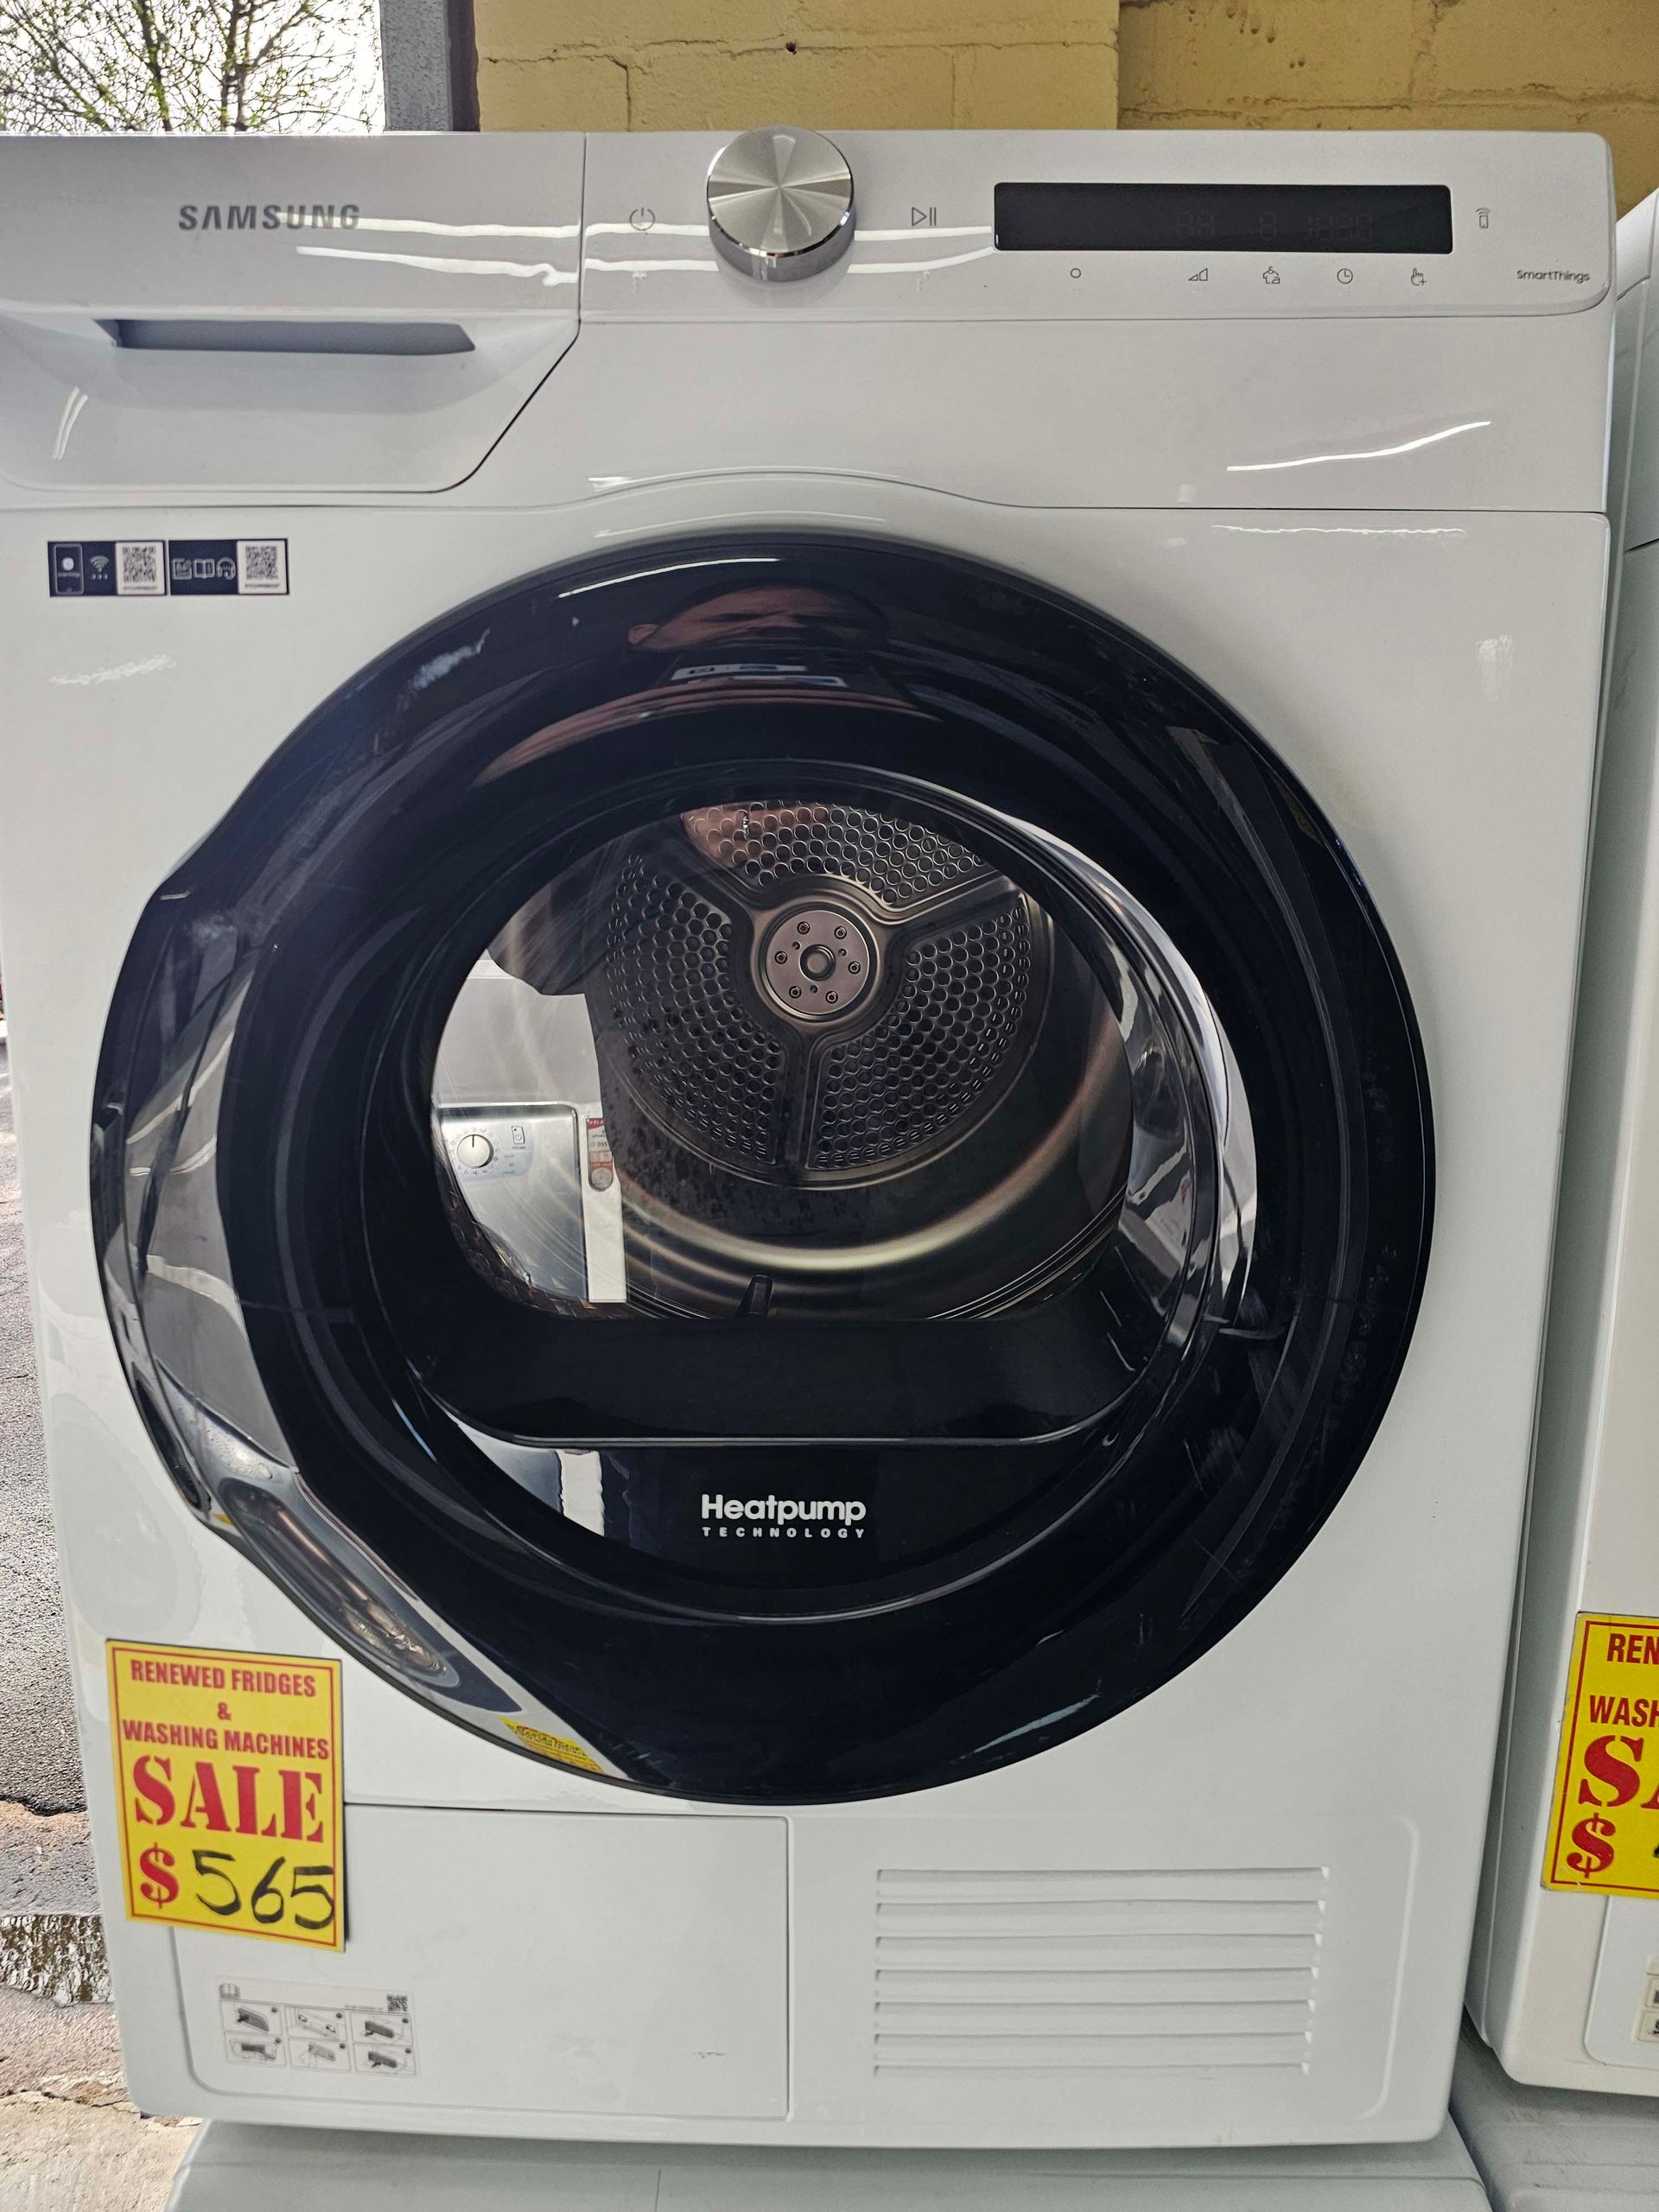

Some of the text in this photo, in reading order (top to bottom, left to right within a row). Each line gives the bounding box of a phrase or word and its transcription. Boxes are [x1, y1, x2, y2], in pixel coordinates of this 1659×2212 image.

[179, 204, 360, 231] SAMSUNG
[1516, 270, 1591, 284] SmartThings
[701, 1493, 868, 1527] Heatpump
[702, 1526, 865, 1539] TECHNOLOGY
[130, 1659, 316, 1698] RENEWED FRIDGES
[217, 1701, 232, 1721] &
[123, 1719, 329, 1760] WASHING MACHINES
[1578, 1734, 1659, 1809] S
[132, 1754, 324, 1844] SALE
[1567, 1812, 1616, 1878] $
[139, 1841, 334, 1930] $ 565
